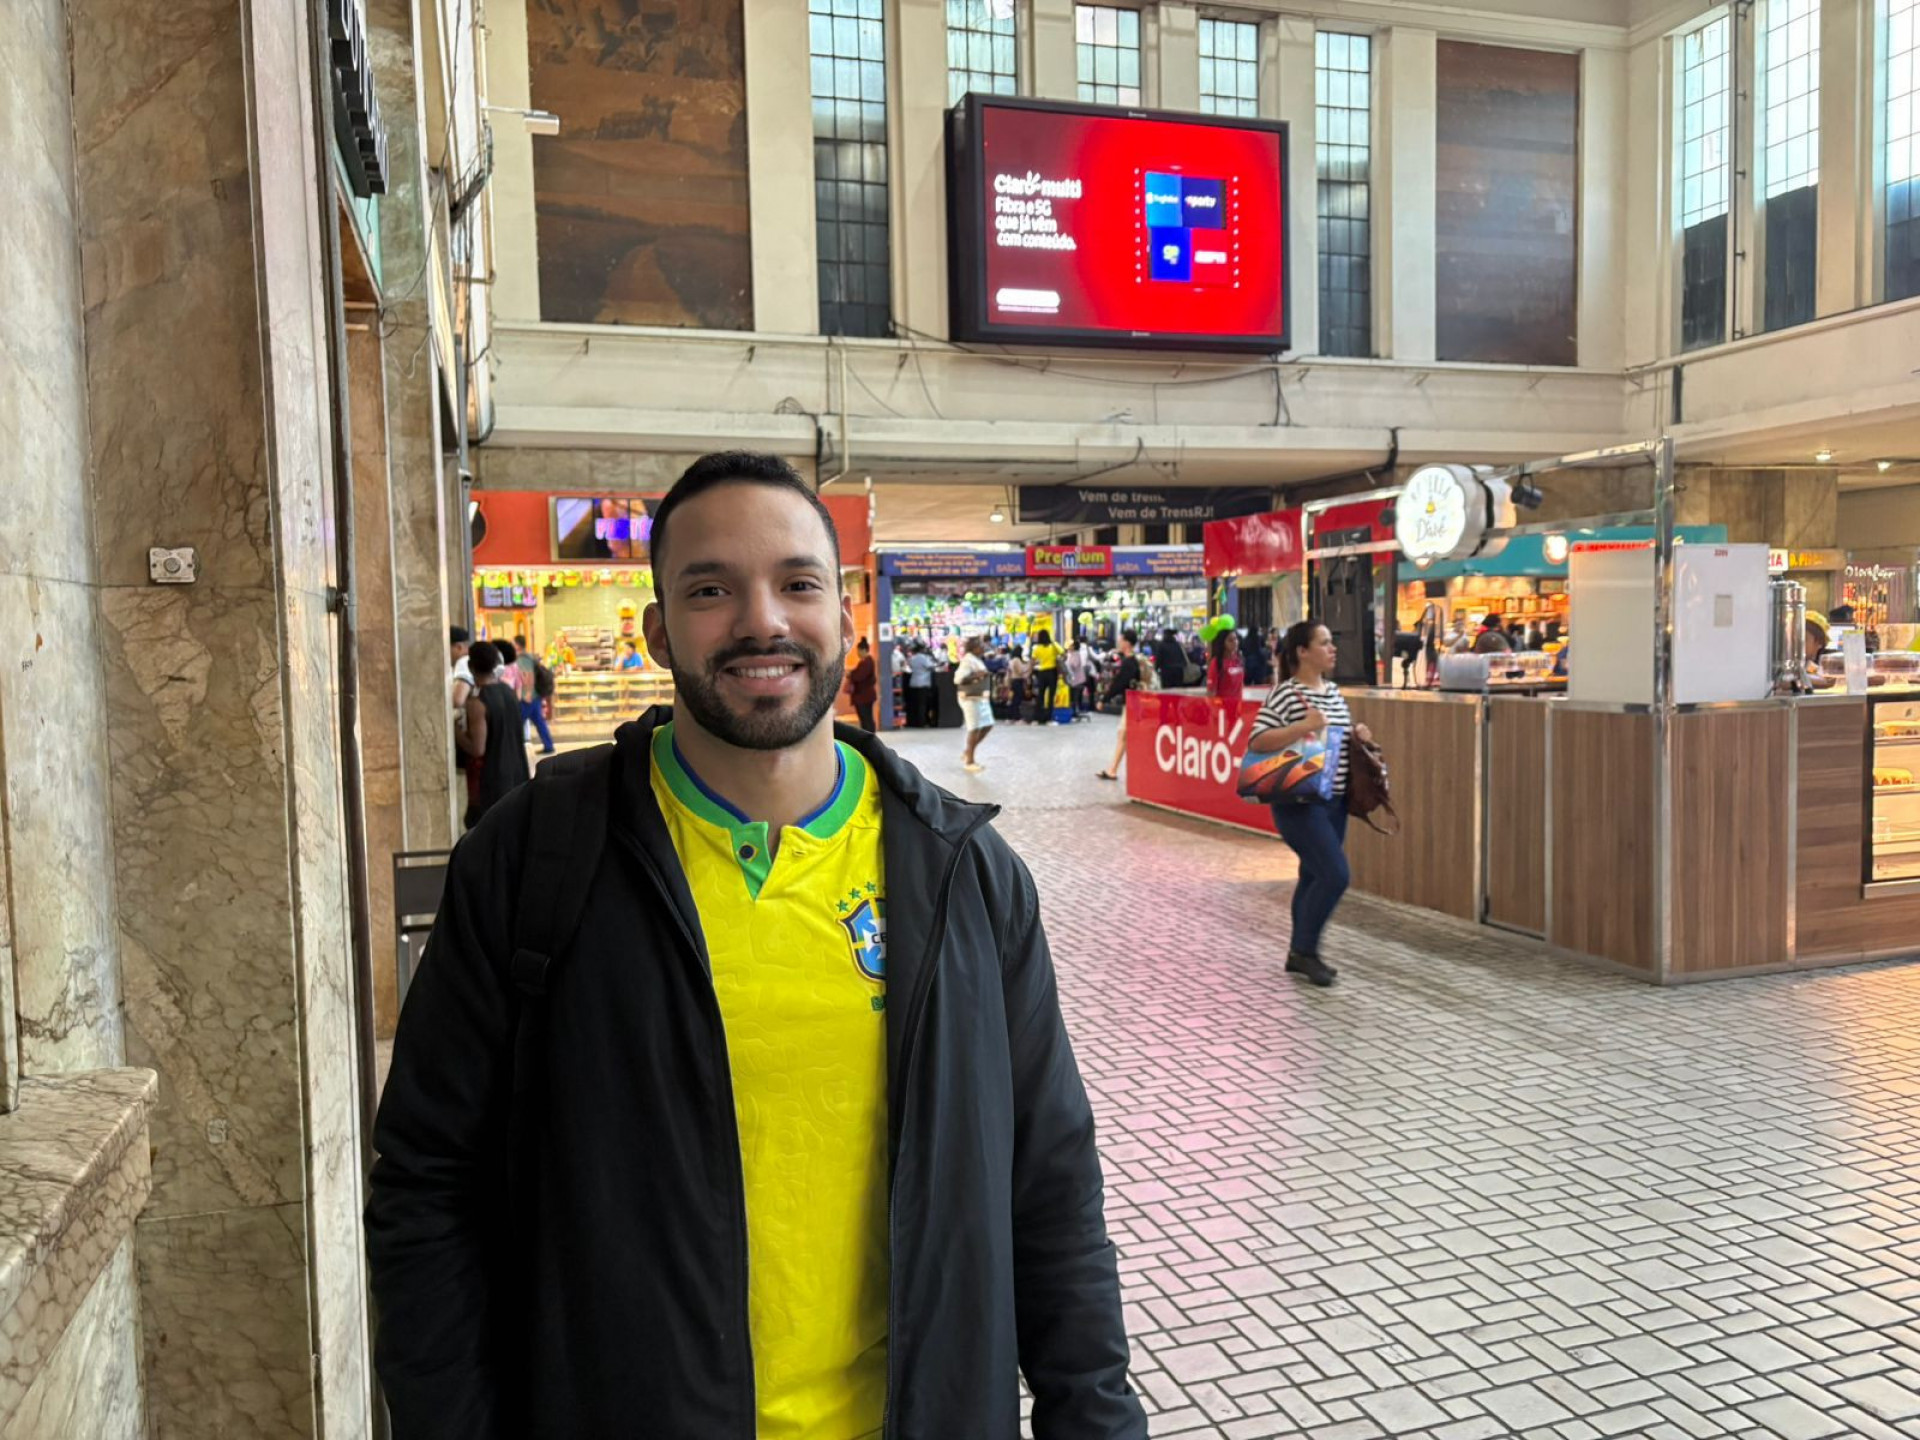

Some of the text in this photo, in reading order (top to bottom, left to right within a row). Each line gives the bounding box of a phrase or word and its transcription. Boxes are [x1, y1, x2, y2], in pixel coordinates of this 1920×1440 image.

[996, 196, 1025, 214] Fibra
[1034, 198, 1052, 217] 5G
[995, 215, 1019, 232] que
[1079, 490, 1108, 503] Vem
[1111, 491, 1128, 502] de
[1108, 506, 1137, 519] Vem
[1140, 506, 1157, 518] de
[1035, 546, 1105, 567] Premium
[1155, 709, 1243, 784] Claro
